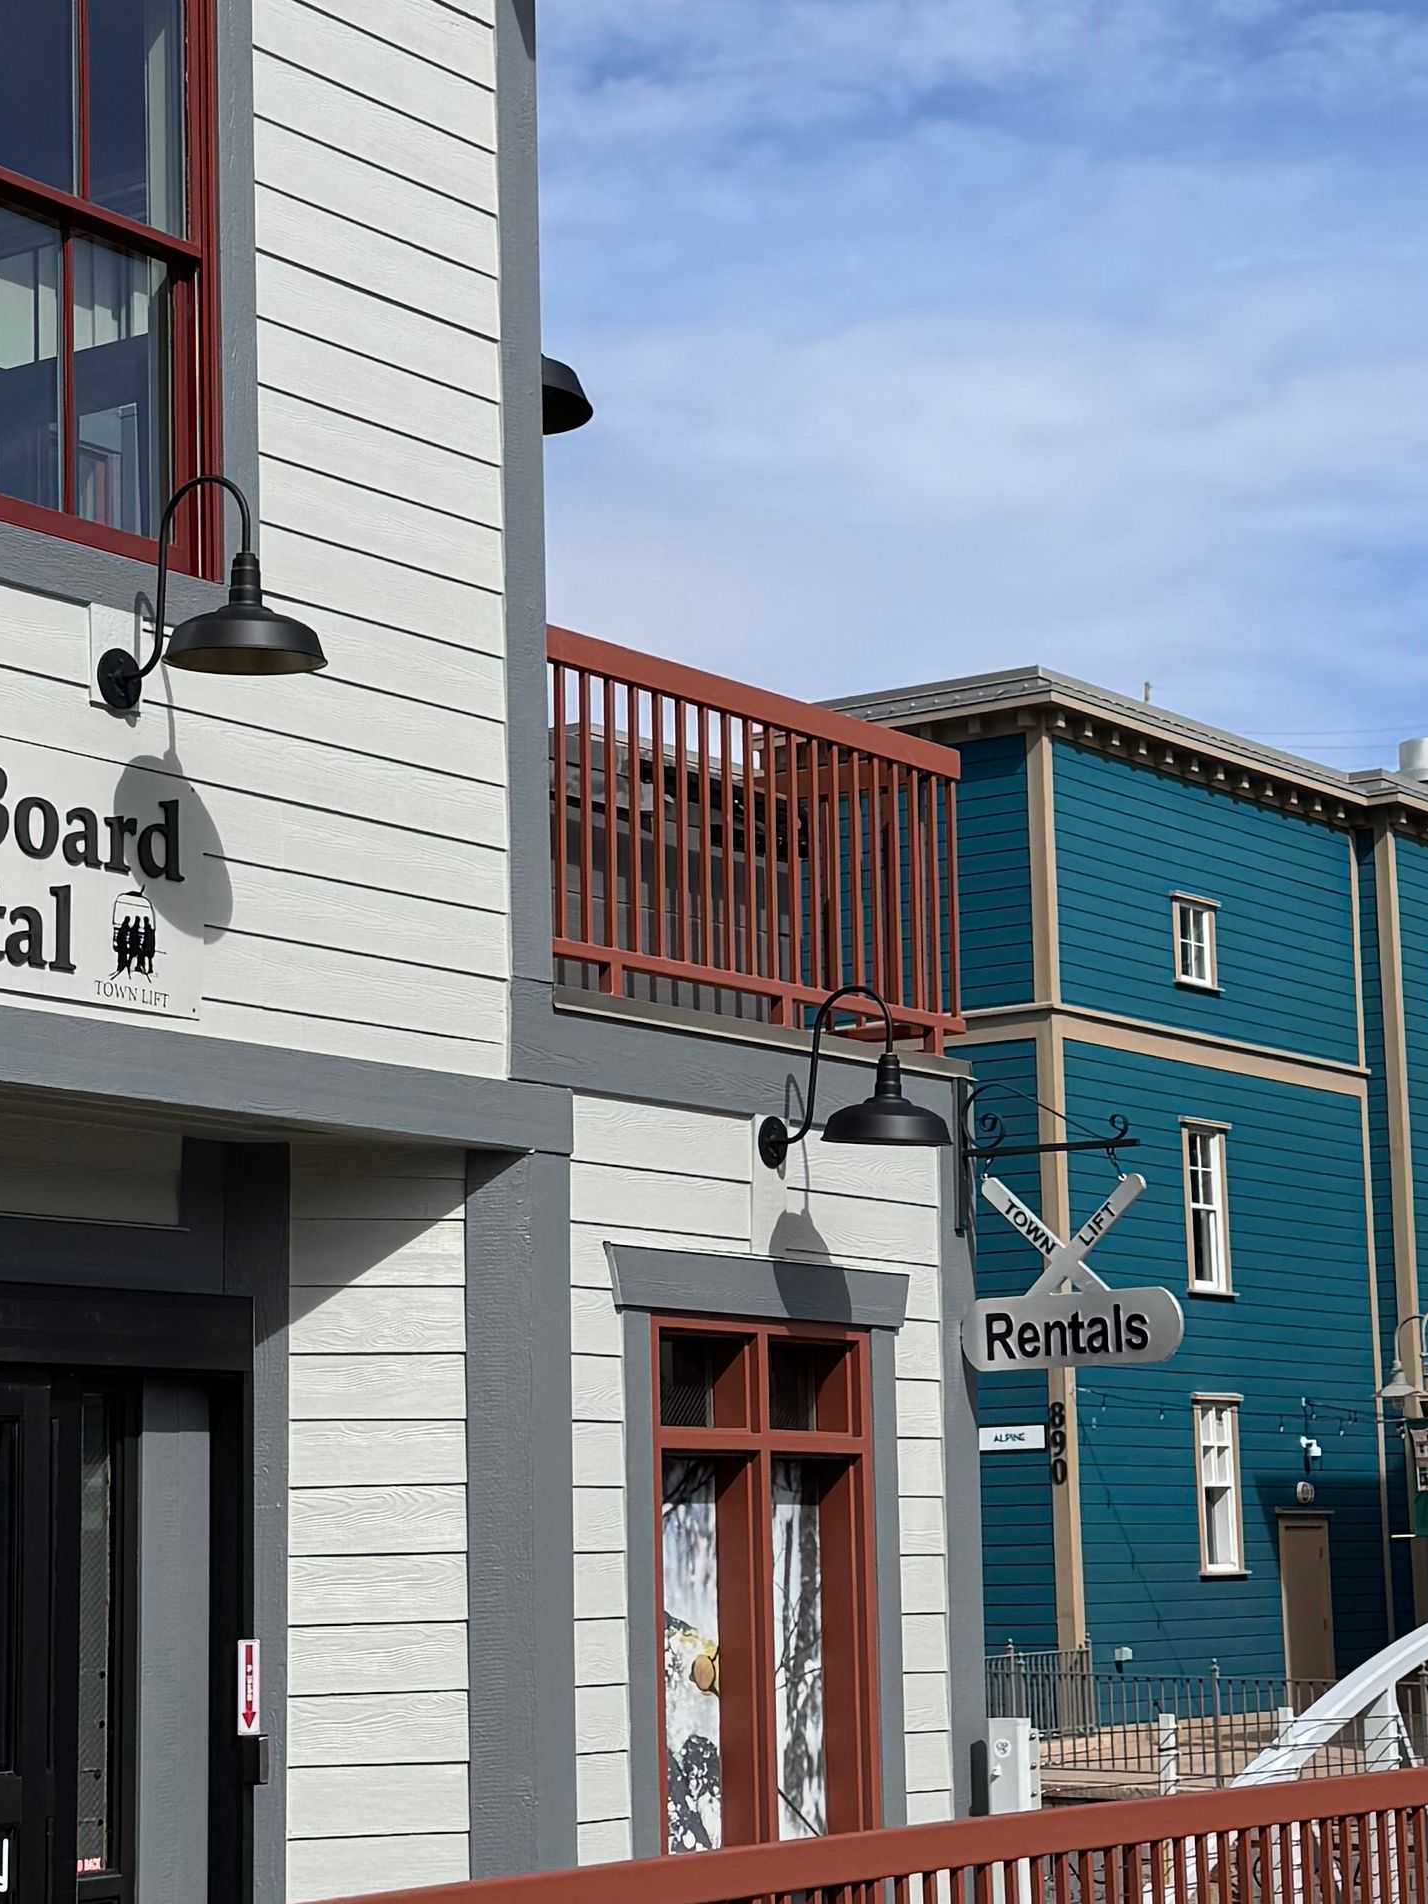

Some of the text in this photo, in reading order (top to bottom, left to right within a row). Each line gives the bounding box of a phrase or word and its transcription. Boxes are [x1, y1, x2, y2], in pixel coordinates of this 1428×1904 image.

[94, 979, 170, 1008] TOWN LIFT
[1004, 1199, 1117, 1255] TOWN LIFT
[985, 1303, 1150, 1361] Rentals
[1050, 1401, 1068, 1486] 890
